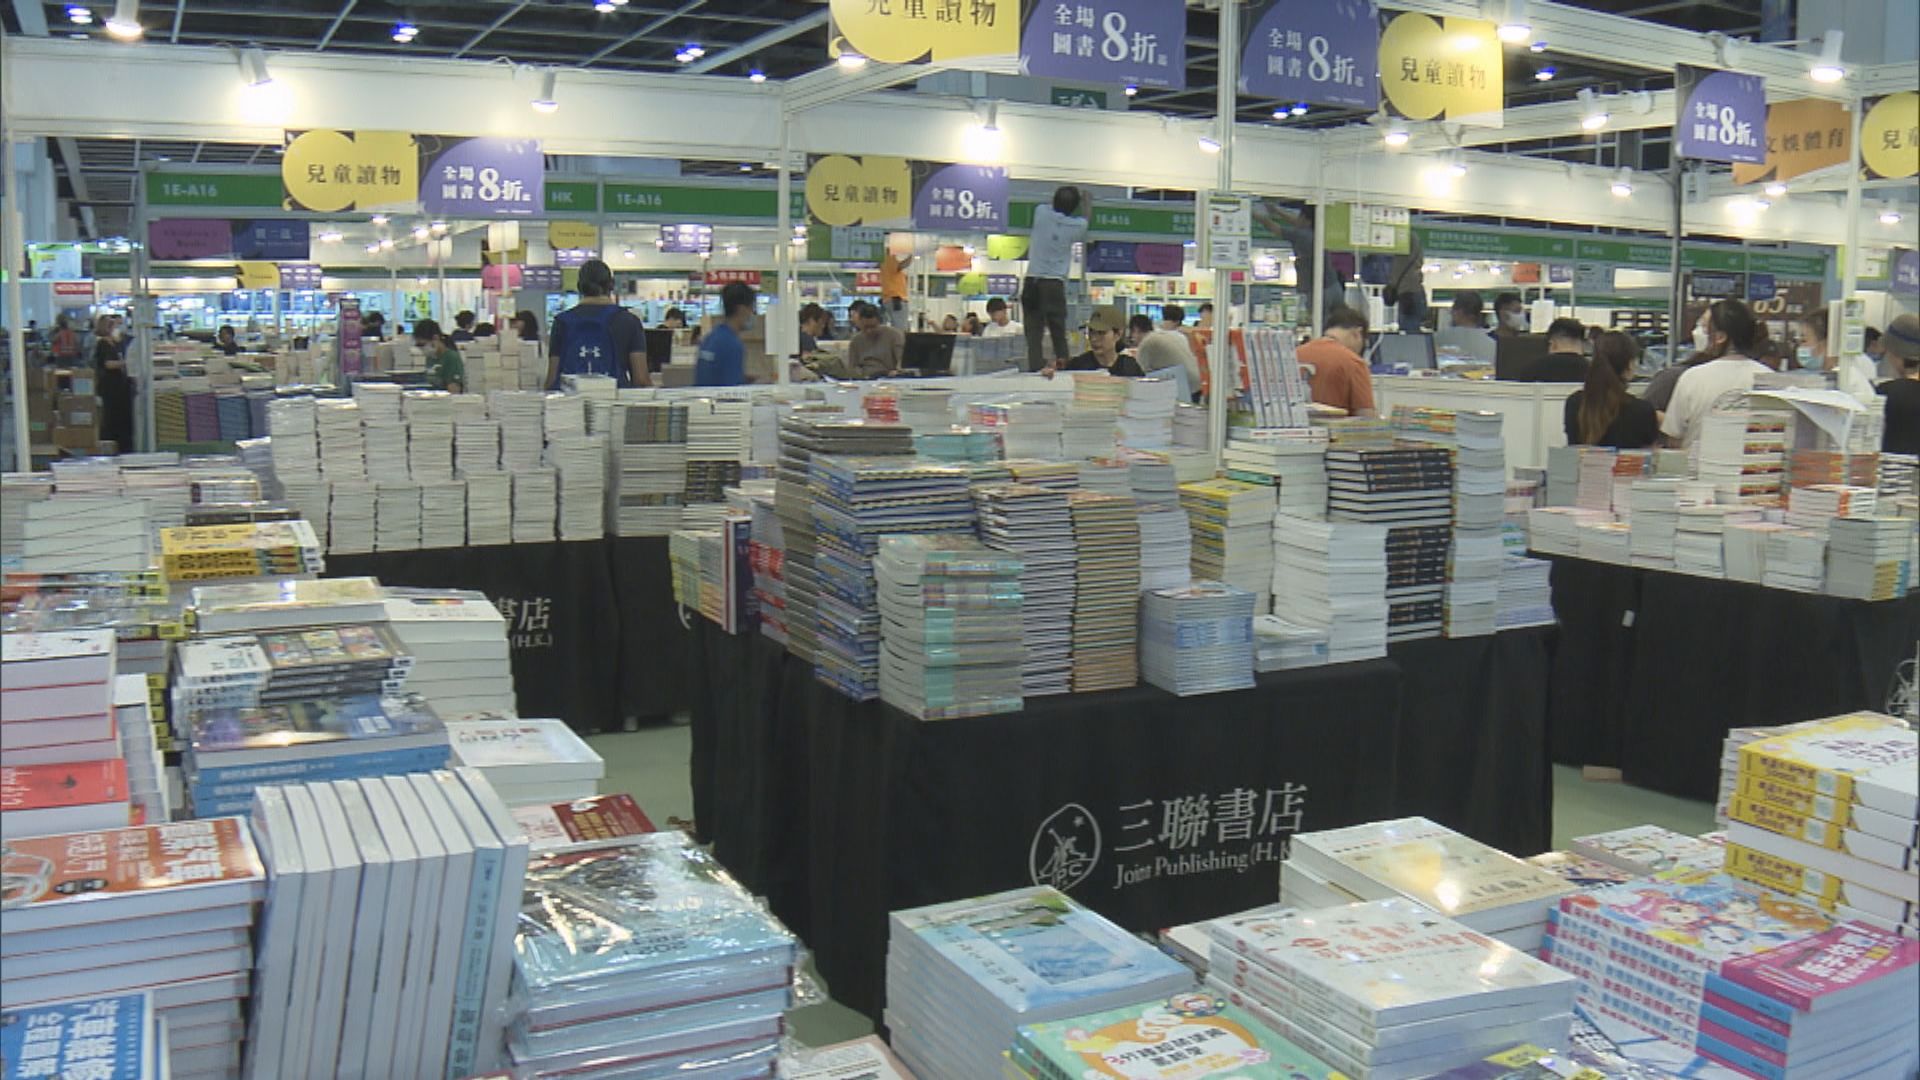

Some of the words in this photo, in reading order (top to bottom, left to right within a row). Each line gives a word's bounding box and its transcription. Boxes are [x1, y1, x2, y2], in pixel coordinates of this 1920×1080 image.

[1053, 3, 1096, 29] 全場
[1053, 33, 1096, 58] 圖書
[1268, 28, 1303, 52] 全場
[1267, 54, 1303, 78] 圖書
[1400, 56, 1486, 90] 兒童讀物
[307, 163, 401, 186] 兒童讀物
[442, 165, 475, 182] 全場
[162, 184, 218, 198] 1E-A16
[441, 184, 475, 200] 圖書
[552, 191, 573, 204] HK
[616, 193, 662, 207] 1E-A16
[823, 183, 898, 205] 兒童讀物
[1114, 782, 1308, 852] 三聯書店
[1113, 863, 1152, 890] Joint
[1155, 850, 1249, 878] Publishing
